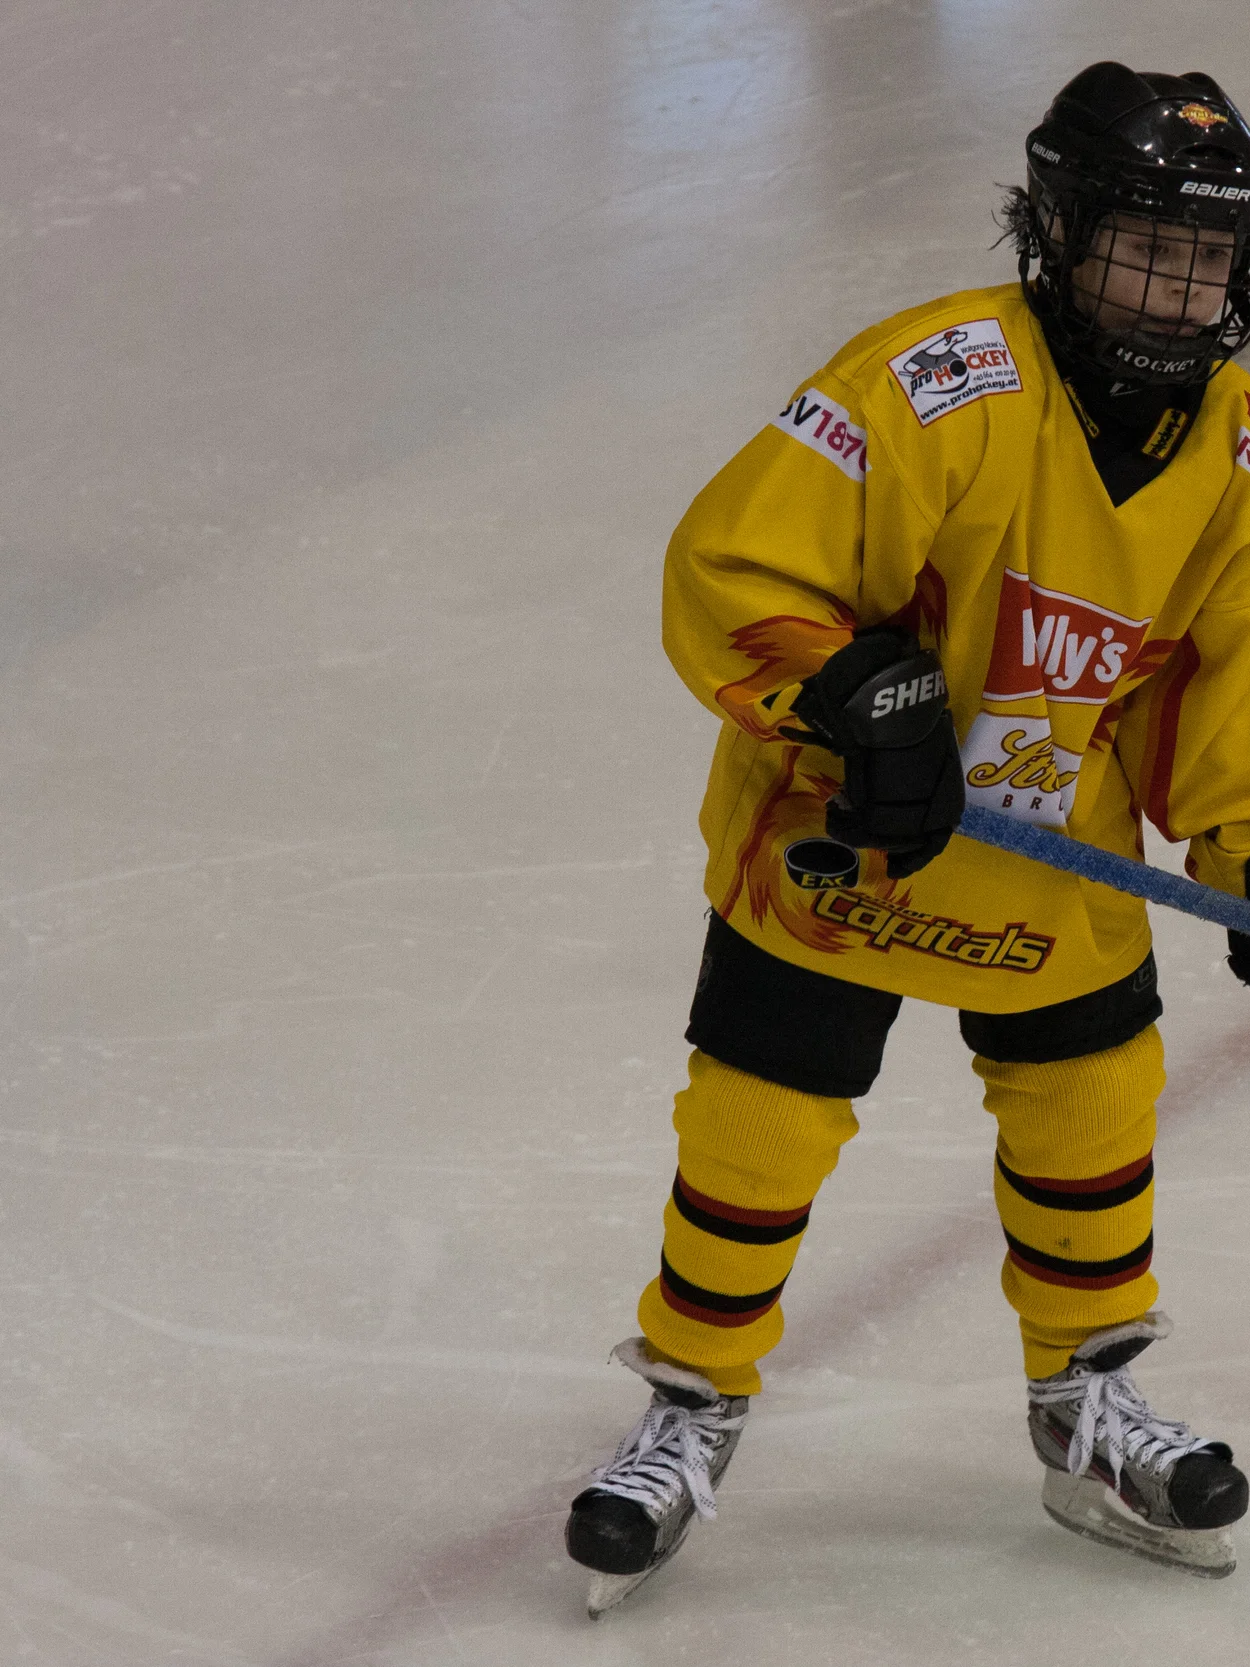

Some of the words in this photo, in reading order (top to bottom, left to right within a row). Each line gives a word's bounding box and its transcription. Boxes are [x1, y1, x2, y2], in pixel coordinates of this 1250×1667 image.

[1031, 142, 1061, 165] BAUER
[1116, 347, 1196, 373] HOCKEY
[920, 378, 1019, 421] www.prohockey.at
